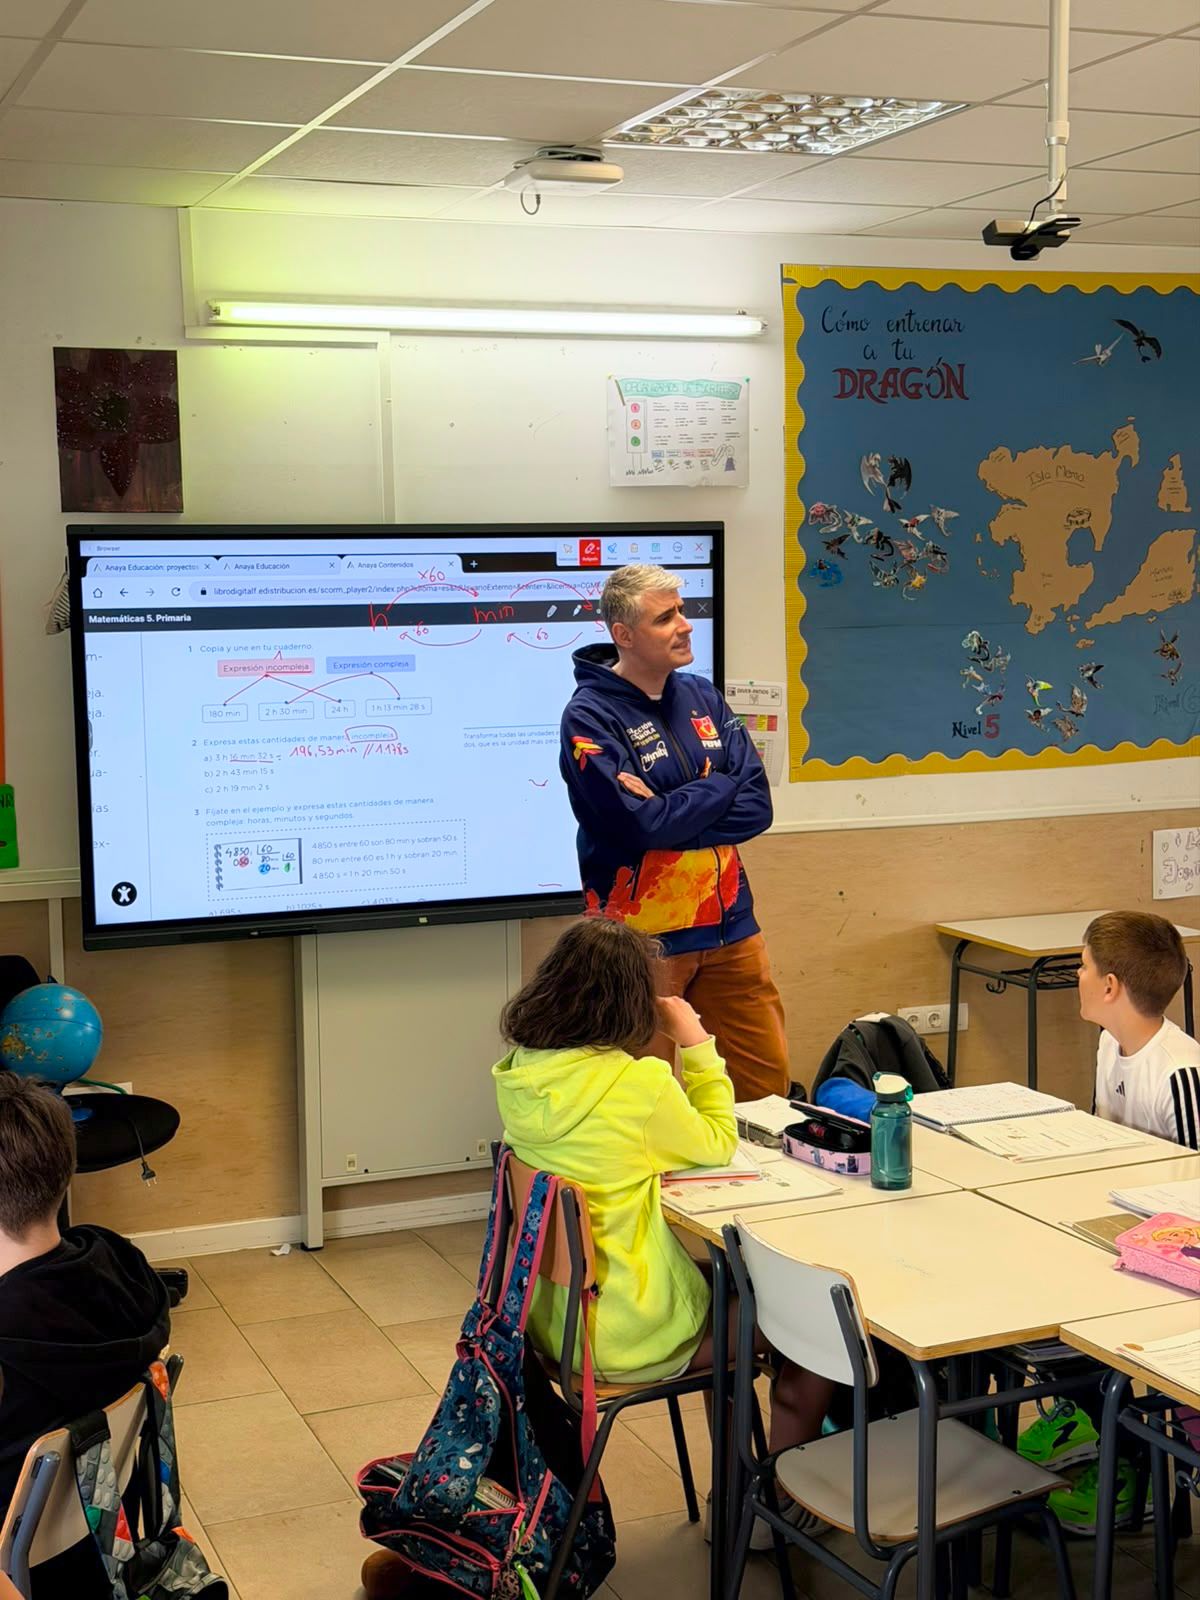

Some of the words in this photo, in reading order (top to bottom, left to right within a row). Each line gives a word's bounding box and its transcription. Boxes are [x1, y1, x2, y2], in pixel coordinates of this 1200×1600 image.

[821, 305, 871, 333] Cómo
[886, 309, 965, 333] entrenar
[863, 344, 877, 360] a
[892, 338, 916, 360] tu
[832, 357, 969, 404] DRAGÓN
[105, 564, 126, 572] Anaya
[234, 563, 254, 571] Anaya
[256, 562, 290, 570] Educación
[89, 614, 145, 624] Matemáticas
[147, 615, 155, 623] 5.
[156, 614, 192, 623] Primaria
[368, 602, 388, 631] h
[474, 605, 514, 624] min
[200, 645, 224, 654] Copia
[223, 664, 264, 673] Expresión
[266, 663, 310, 672] incompleja
[334, 661, 372, 670] Expresión
[374, 660, 409, 669] compleja
[265, 708, 271, 716] 2
[332, 706, 342, 714] 24
[377, 704, 382, 712] h
[209, 710, 223, 718] 180
[952, 722, 982, 739] Nivel
[984, 714, 1000, 739] 5
[204, 738, 237, 746] Expresa
[262, 736, 305, 744] cantidades
[204, 754, 213, 762] a)
[258, 752, 268, 760] 32
[204, 770, 214, 778] b)
[242, 768, 258, 776] min
[205, 786, 214, 794] c)
[223, 785, 229, 793] h
[241, 784, 256, 792] min
[252, 806, 284, 814] ejemplo
[349, 800, 391, 808] cantidades
[274, 815, 306, 823] minutos
[417, 836, 442, 844] sobran
[312, 857, 323, 865] 80
[363, 854, 374, 862] 60
[404, 851, 429, 859] sobran
[374, 868, 388, 876] min
